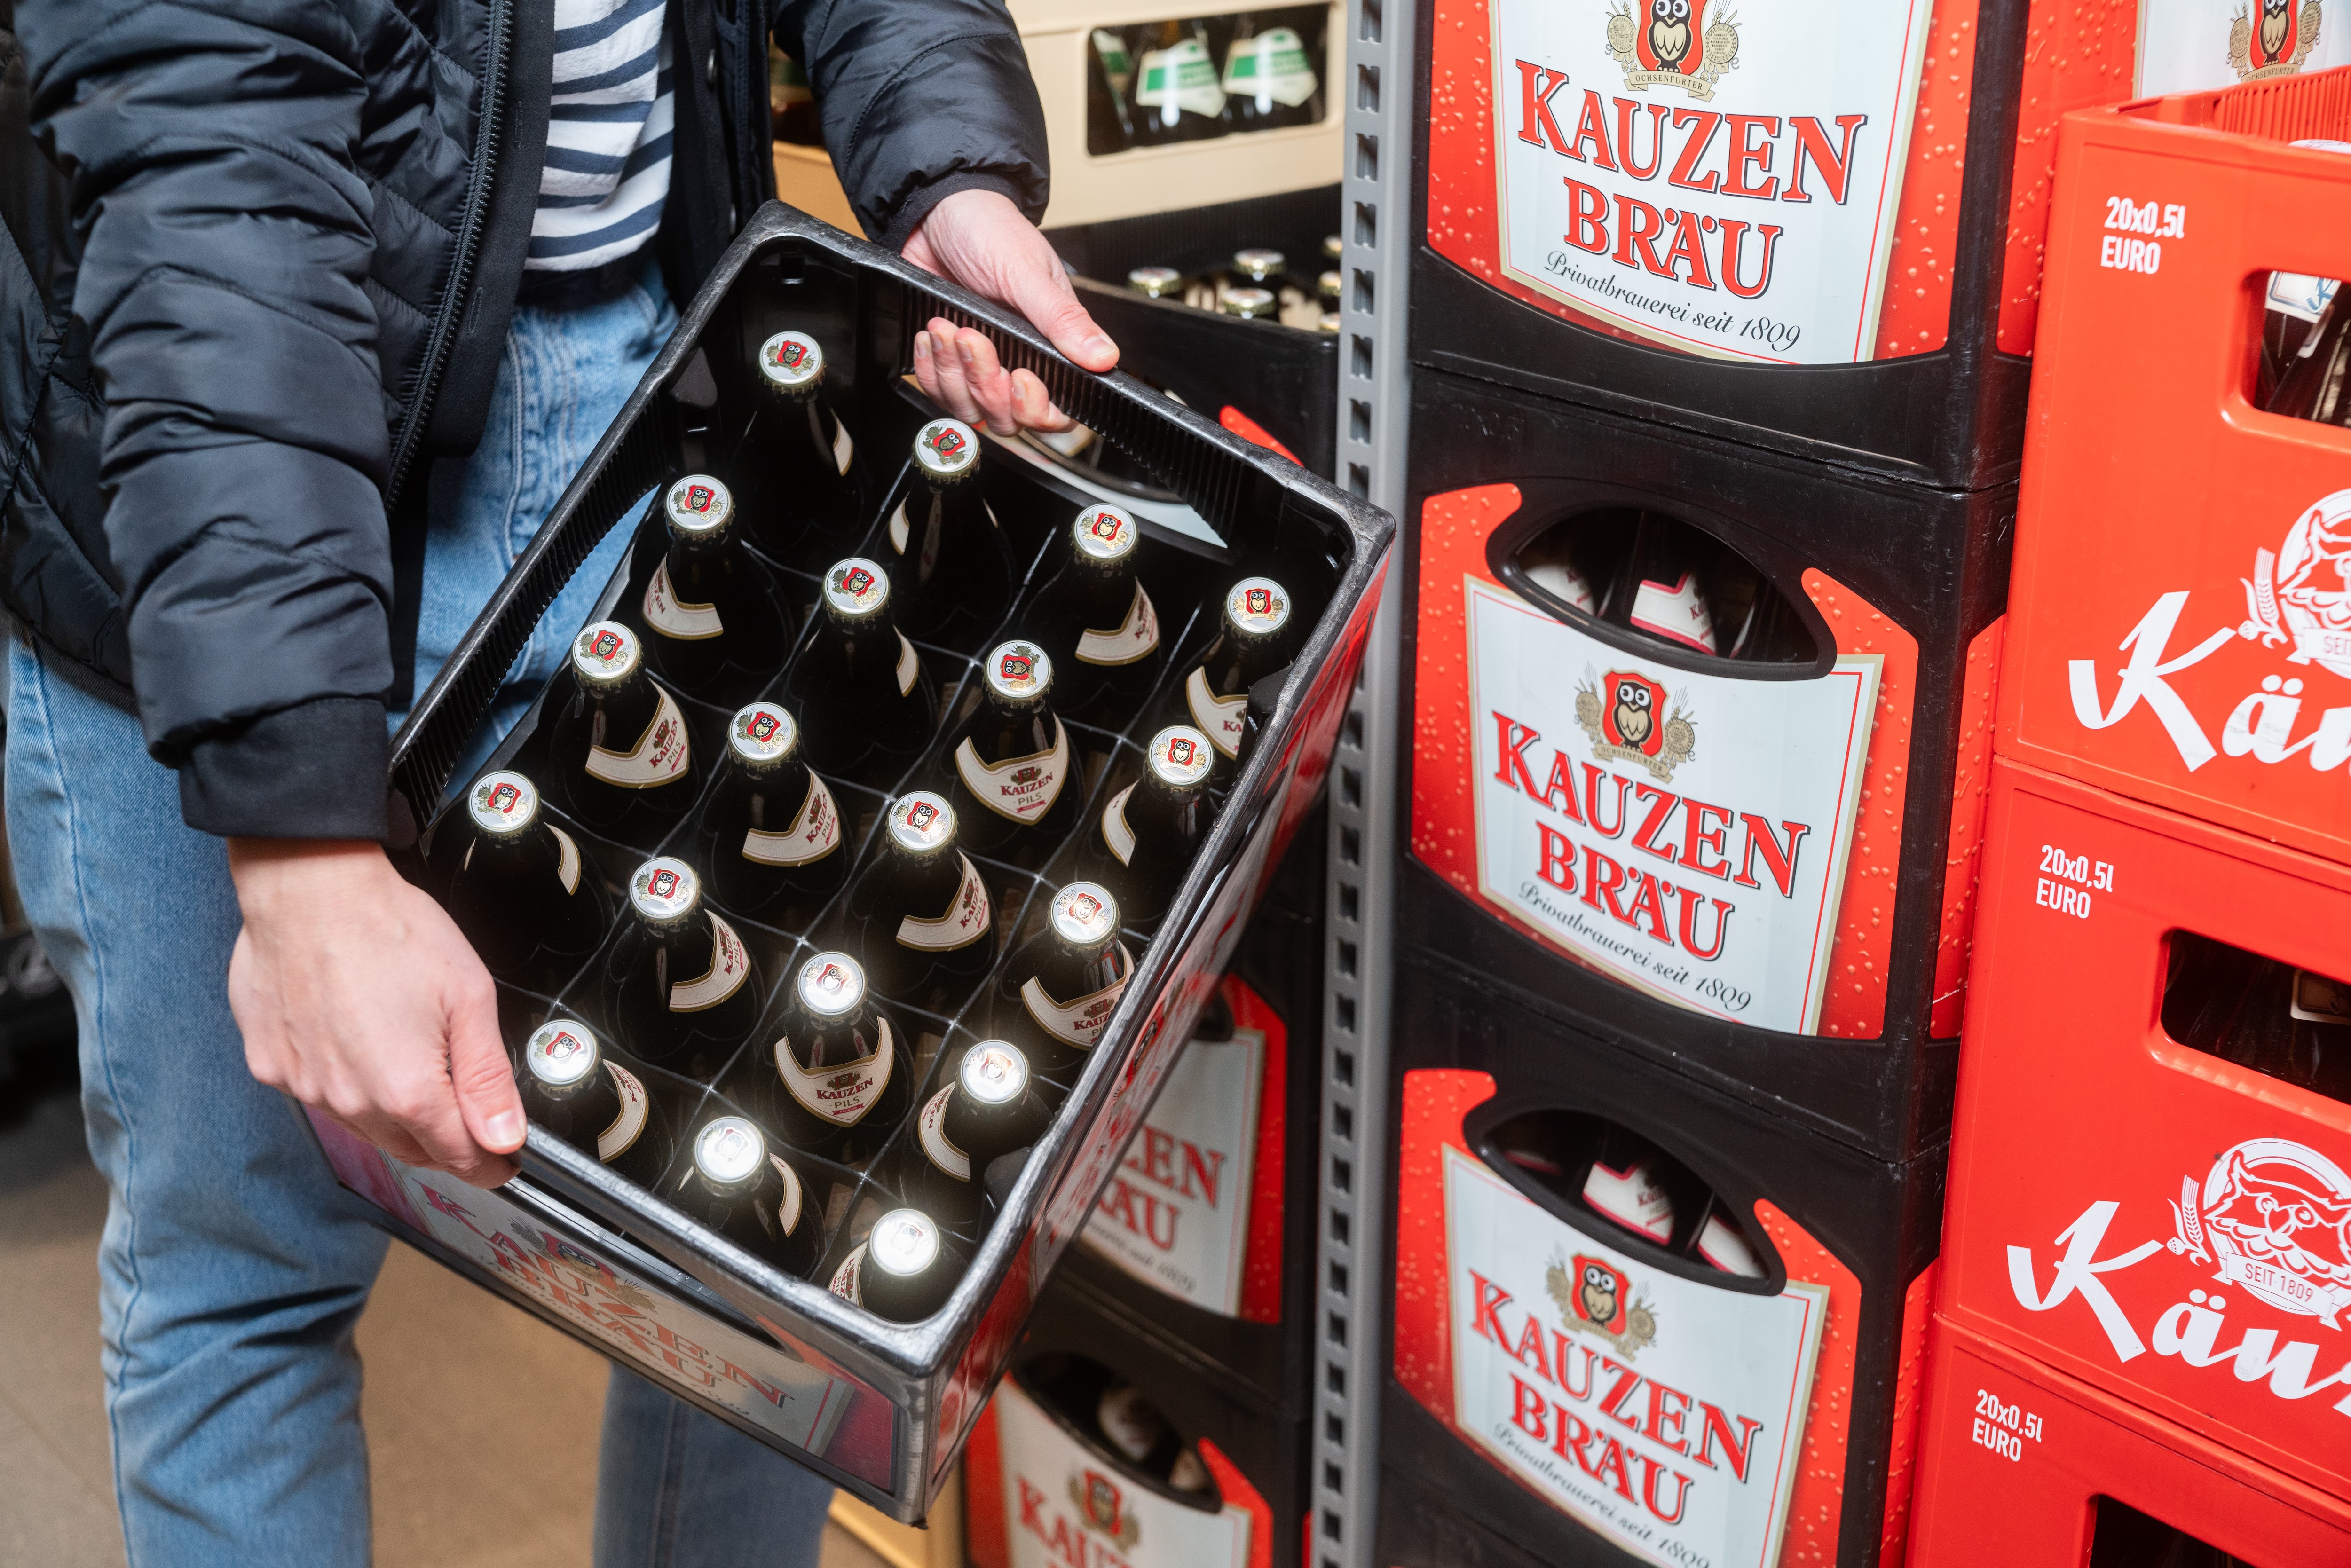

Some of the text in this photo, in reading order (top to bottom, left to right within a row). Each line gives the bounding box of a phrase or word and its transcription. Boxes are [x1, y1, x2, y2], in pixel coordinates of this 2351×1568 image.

[1635, 74, 1703, 91] OCHSENFURTER
[1515, 59, 1868, 207] KAUZEN
[1563, 176, 1783, 301] BRÄU
[2100, 235, 2162, 275] EURO
[1544, 251, 1802, 353] Privatbrauerei seit 1809
[649, 716, 678, 768] KAUZEN
[667, 740, 681, 764] PILS
[1601, 746, 1663, 772] OCHSENFURTER
[1001, 772, 1053, 796] KAUZEN
[1018, 792, 1042, 805] PILS
[1491, 711, 1811, 899] KAUZEN
[822, 812, 832, 837] PILS
[1536, 820, 1735, 962] BRÄU
[2036, 878, 2091, 919] EURO
[1518, 880, 1752, 1012] Privatbrauerei seit 1809
[1073, 1009, 1114, 1030] KAUZ
[1091, 1026, 1103, 1036] PI
[815, 1076, 873, 1100] KAUZEN
[834, 1096, 860, 1109] PILS
[412, 1177, 795, 1410] KAUZEN
[840, 1257, 856, 1300] KAUZ
[2245, 1263, 2314, 1302] SEIT 1809
[2007, 1200, 2351, 1417] Käu
[1468, 1269, 1764, 1483] KAUZEN
[1509, 1372, 1694, 1527] BRÄU
[1972, 1420, 2022, 1462] EURO
[1617, 1515, 1653, 1542] seit
[1659, 1536, 1712, 1568] 1809
